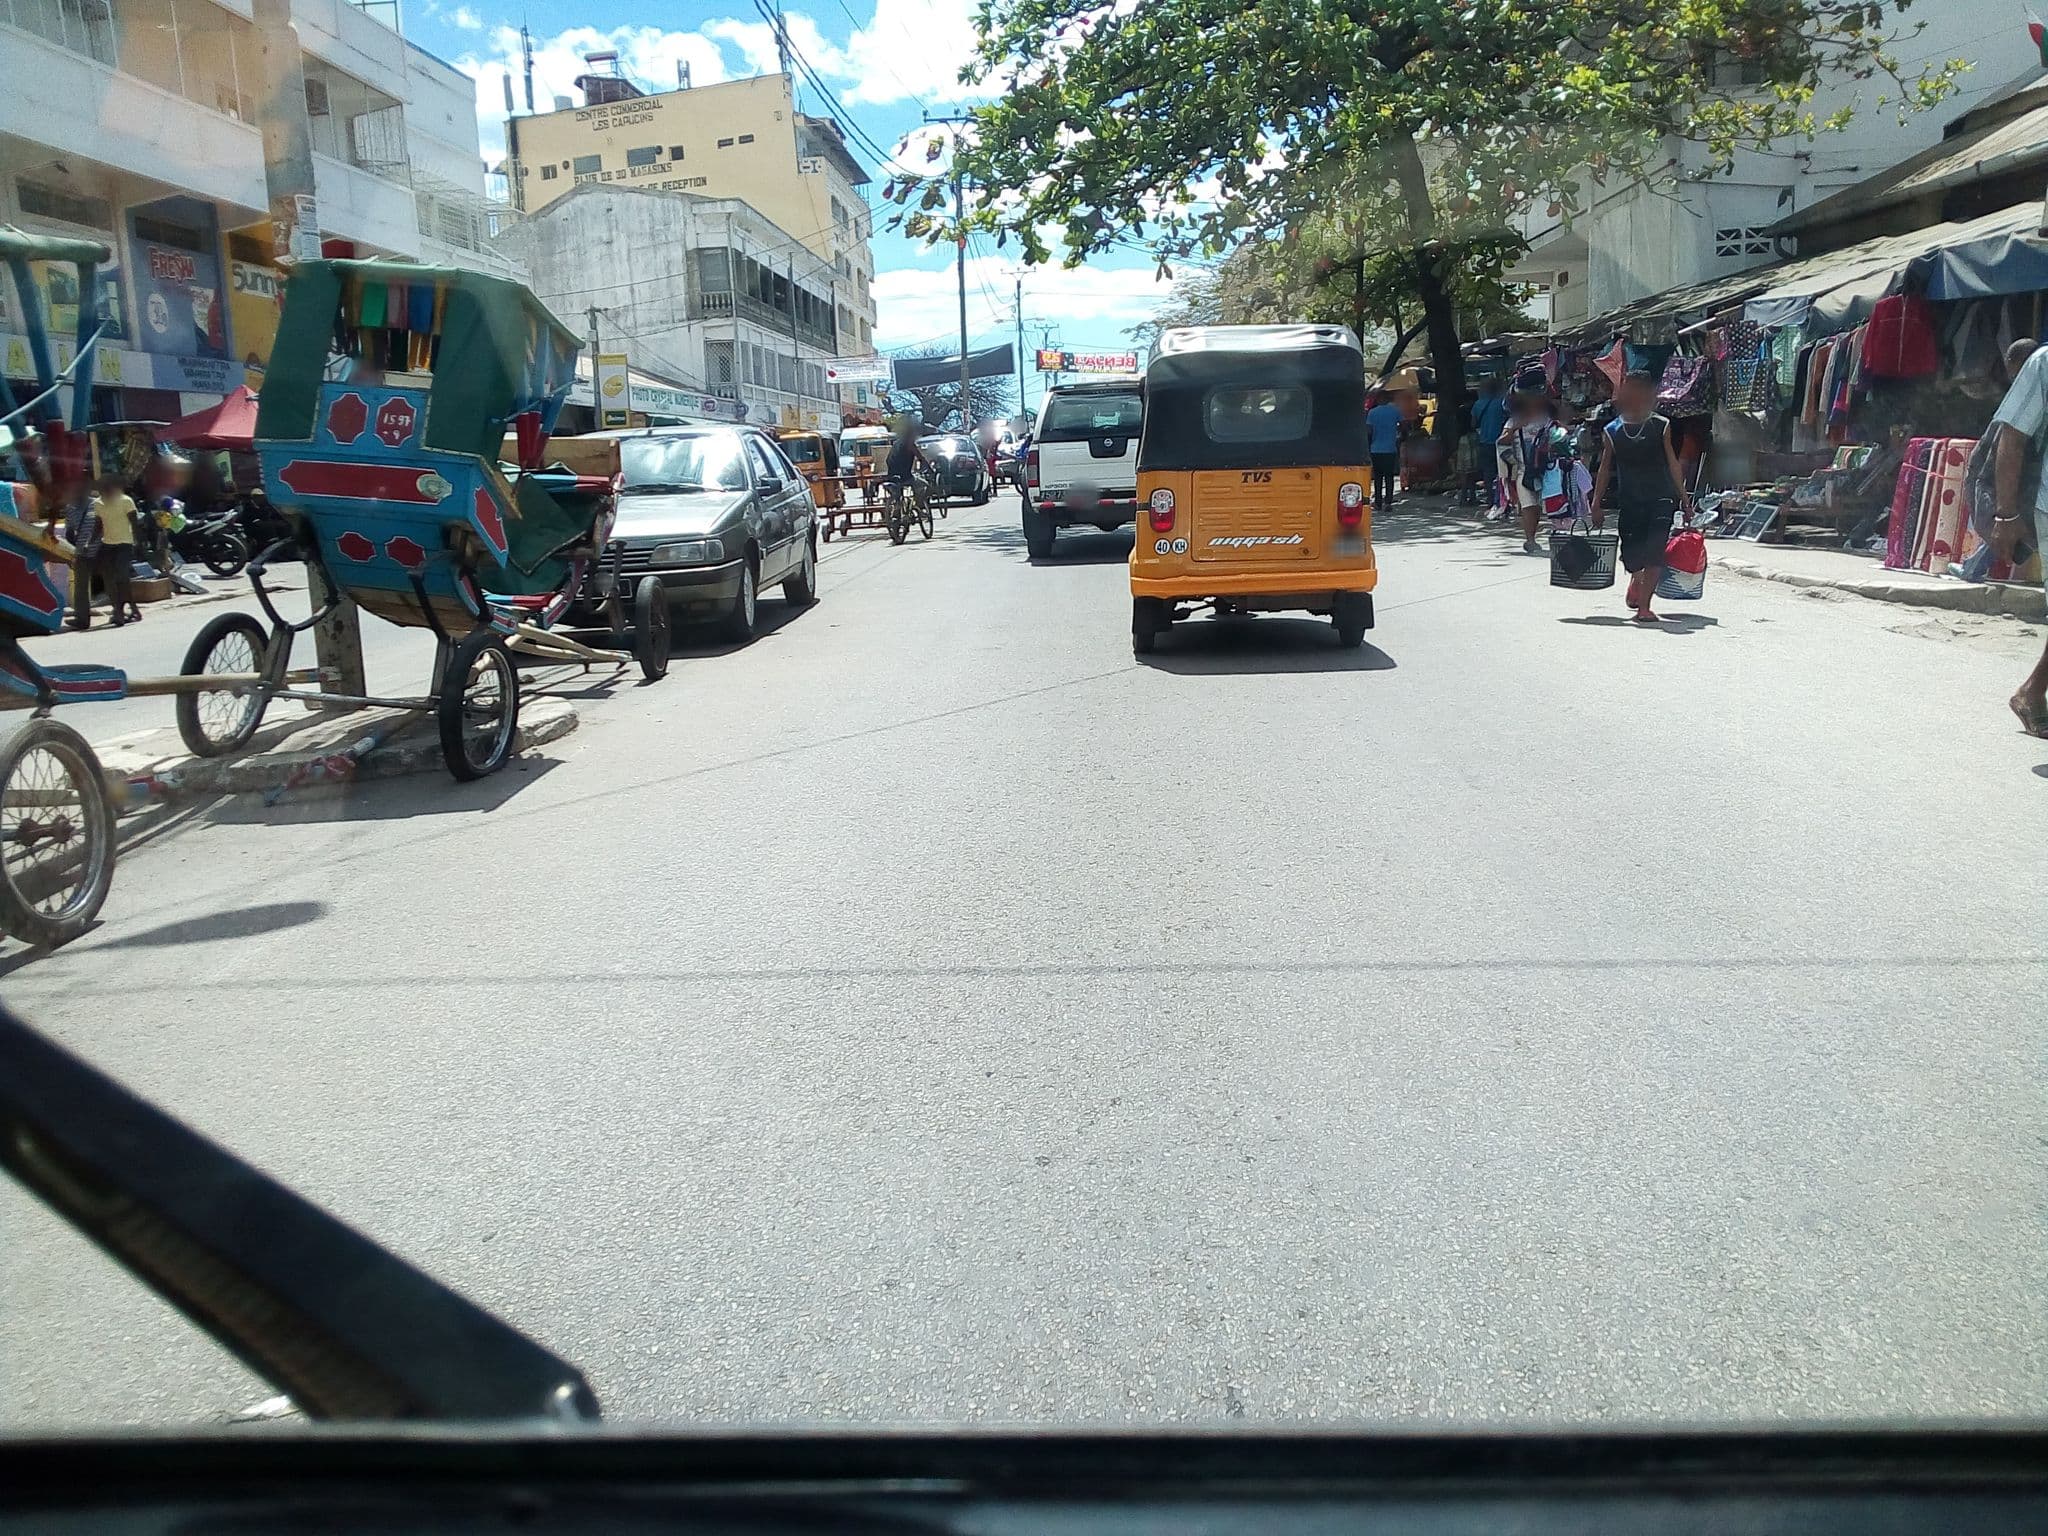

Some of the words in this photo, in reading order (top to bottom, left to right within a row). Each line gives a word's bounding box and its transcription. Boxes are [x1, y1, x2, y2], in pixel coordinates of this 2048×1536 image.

[576, 108, 609, 121] CENTRE
[611, 99, 663, 116] COMMERCIAL
[592, 120, 609, 131] LES
[612, 112, 654, 128] CAPUCINS
[574, 173, 598, 185] PLUS
[601, 171, 612, 181] DE
[616, 169, 626, 179] 30
[630, 162, 672, 178] MAGASINS
[662, 176, 707, 191] RECEPTION
[632, 386, 649, 401] PHOTO
[1241, 472, 1272, 484] TVS
